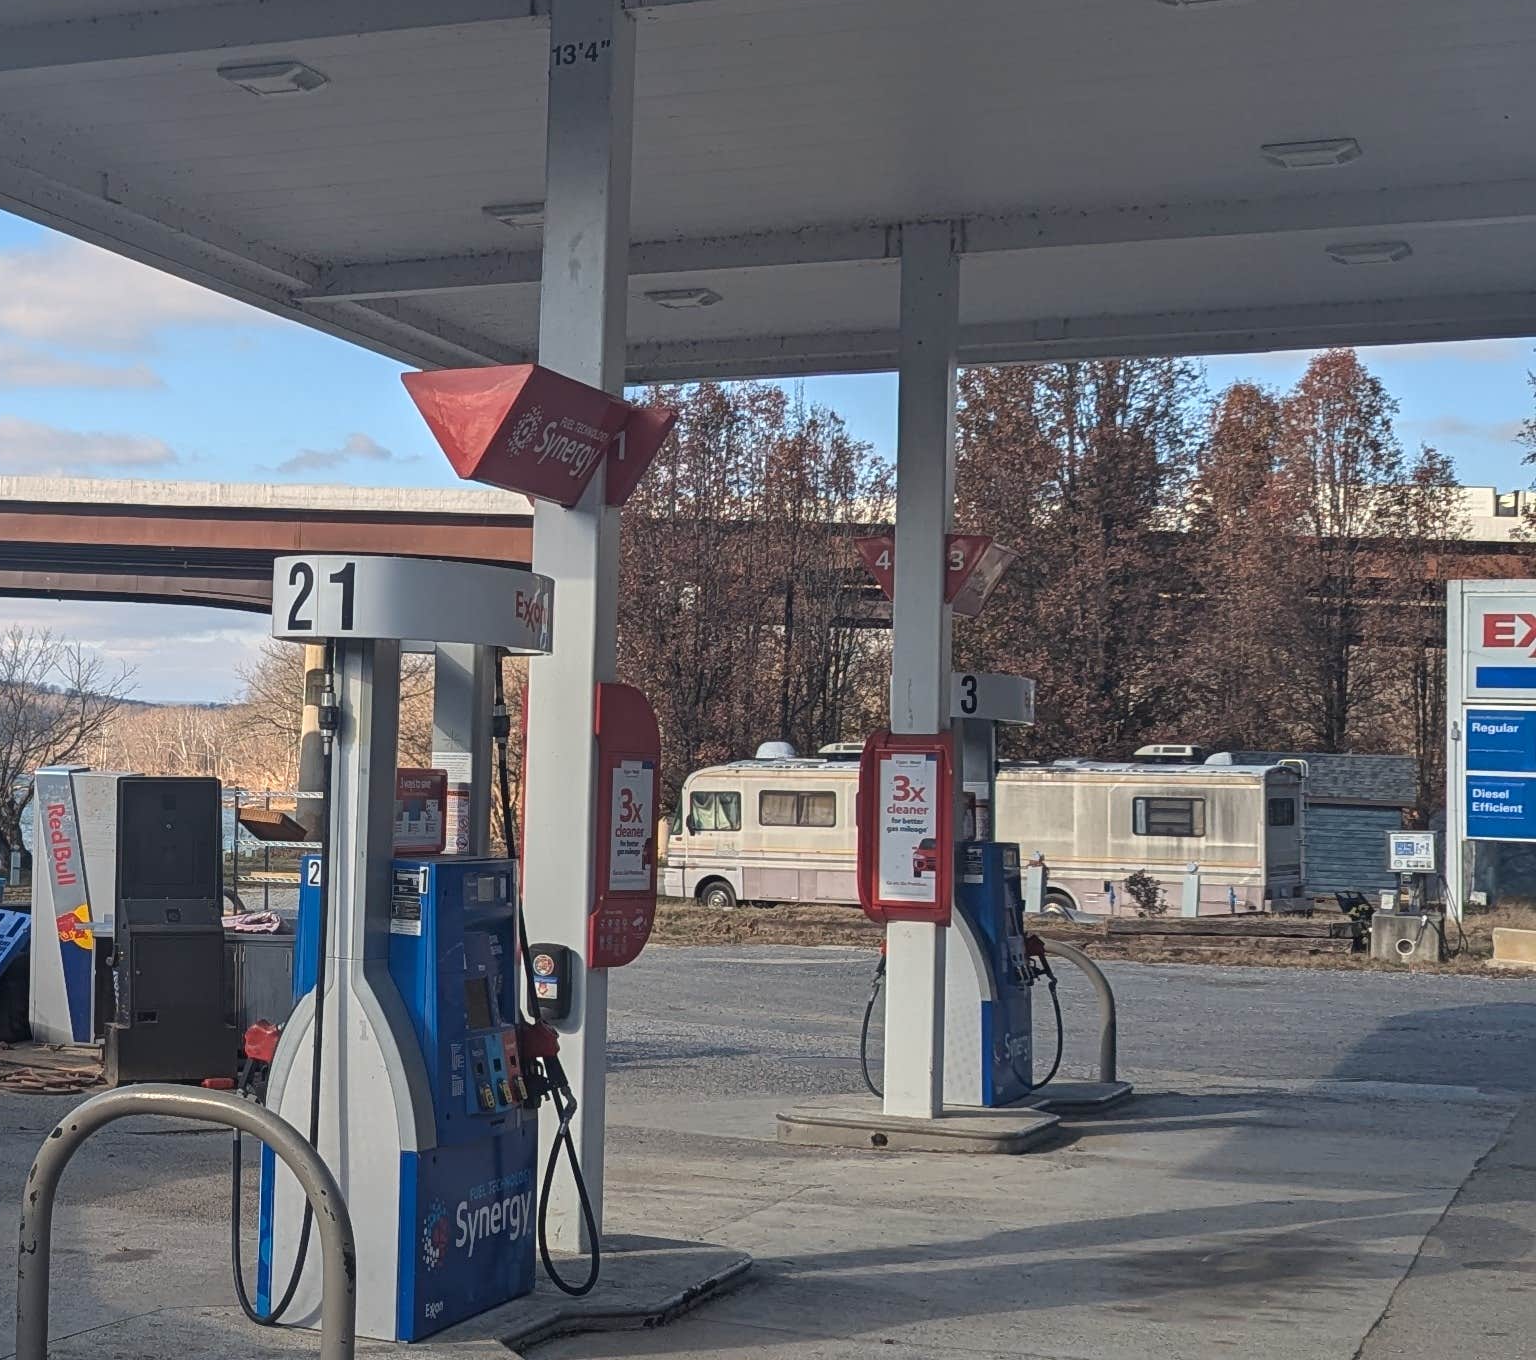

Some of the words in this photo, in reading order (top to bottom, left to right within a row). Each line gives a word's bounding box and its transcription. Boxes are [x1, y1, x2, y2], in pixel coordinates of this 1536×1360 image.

[552, 39, 611, 66] 13'4"
[533, 421, 601, 478] Synergy
[614, 430, 626, 460] 1
[875, 550, 892, 571] 4
[949, 550, 965, 571] 3
[961, 675, 978, 715] 3
[1471, 722, 1520, 735] Regular
[893, 775, 927, 802] 3x
[1472, 788, 1510, 800] Diesel
[620, 788, 643, 823] 3x
[886, 803, 929, 815] cleaner
[1471, 801, 1524, 814] Efficient
[47, 802, 70, 845] Red
[615, 824, 644, 838] cleaner
[886, 826, 899, 834] gas
[891, 817, 902, 825] for
[902, 817, 924, 825] better
[53, 846, 76, 886] Bull
[309, 861, 320, 885] 2
[421, 868, 428, 893] 1
[455, 1191, 532, 1257] Synergy
[425, 1300, 444, 1320] Exxon
